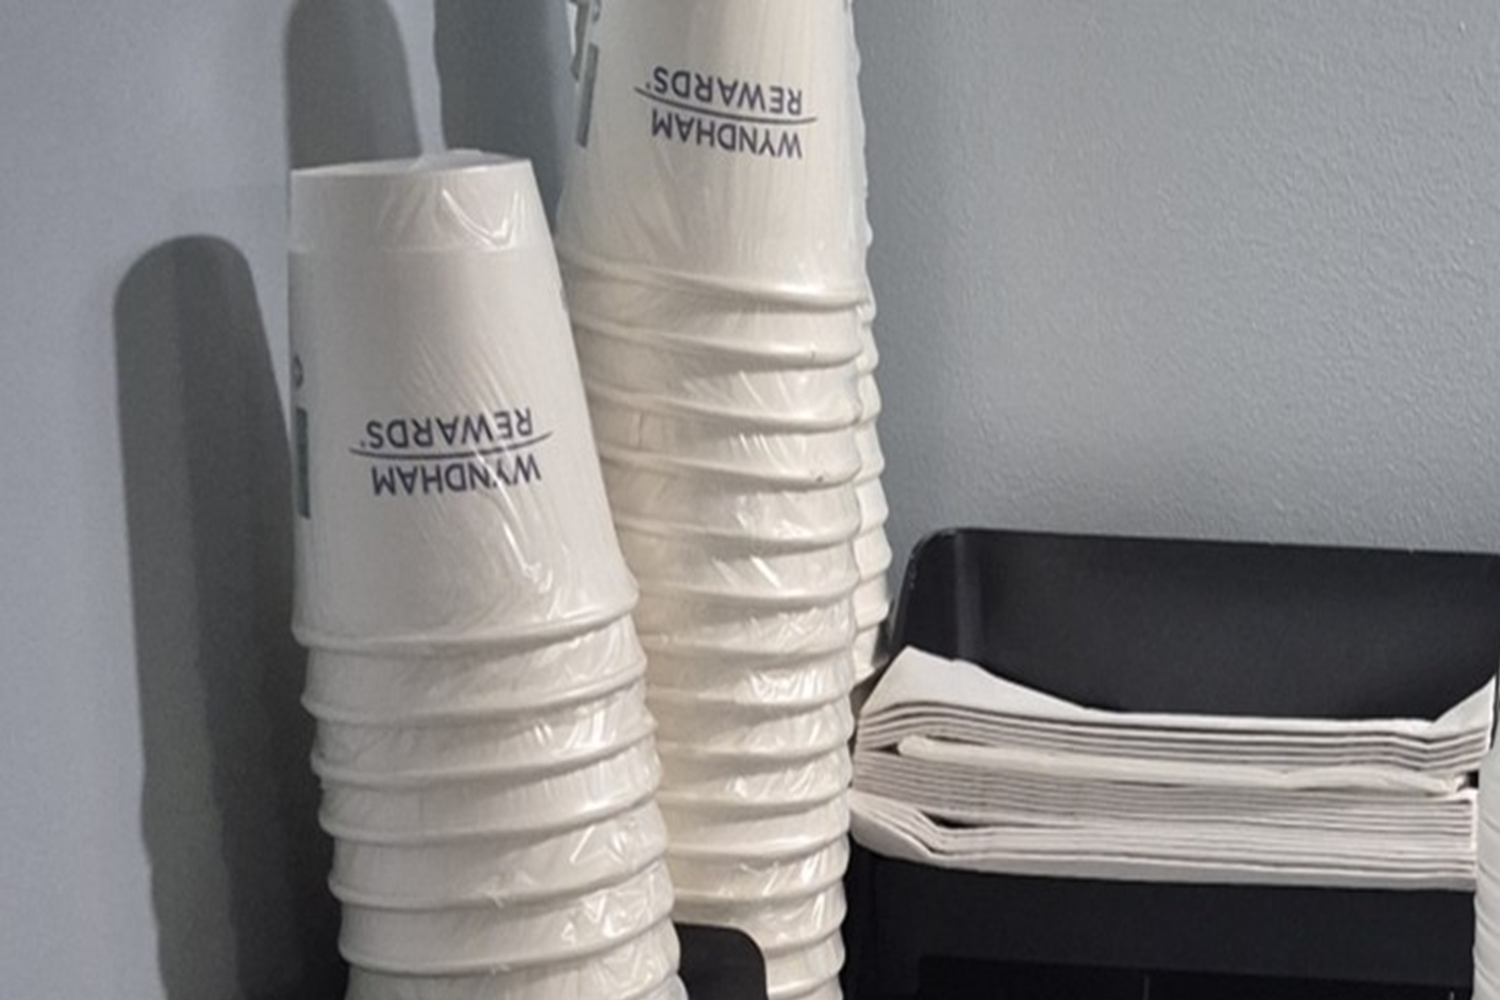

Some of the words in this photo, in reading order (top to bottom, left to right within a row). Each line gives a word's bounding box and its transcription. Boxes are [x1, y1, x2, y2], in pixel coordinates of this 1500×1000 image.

[651, 65, 803, 116] REWARDS
[651, 107, 803, 160] WYNDHAM
[366, 406, 534, 450] REWARDS
[371, 452, 543, 496] WYNDHAM
